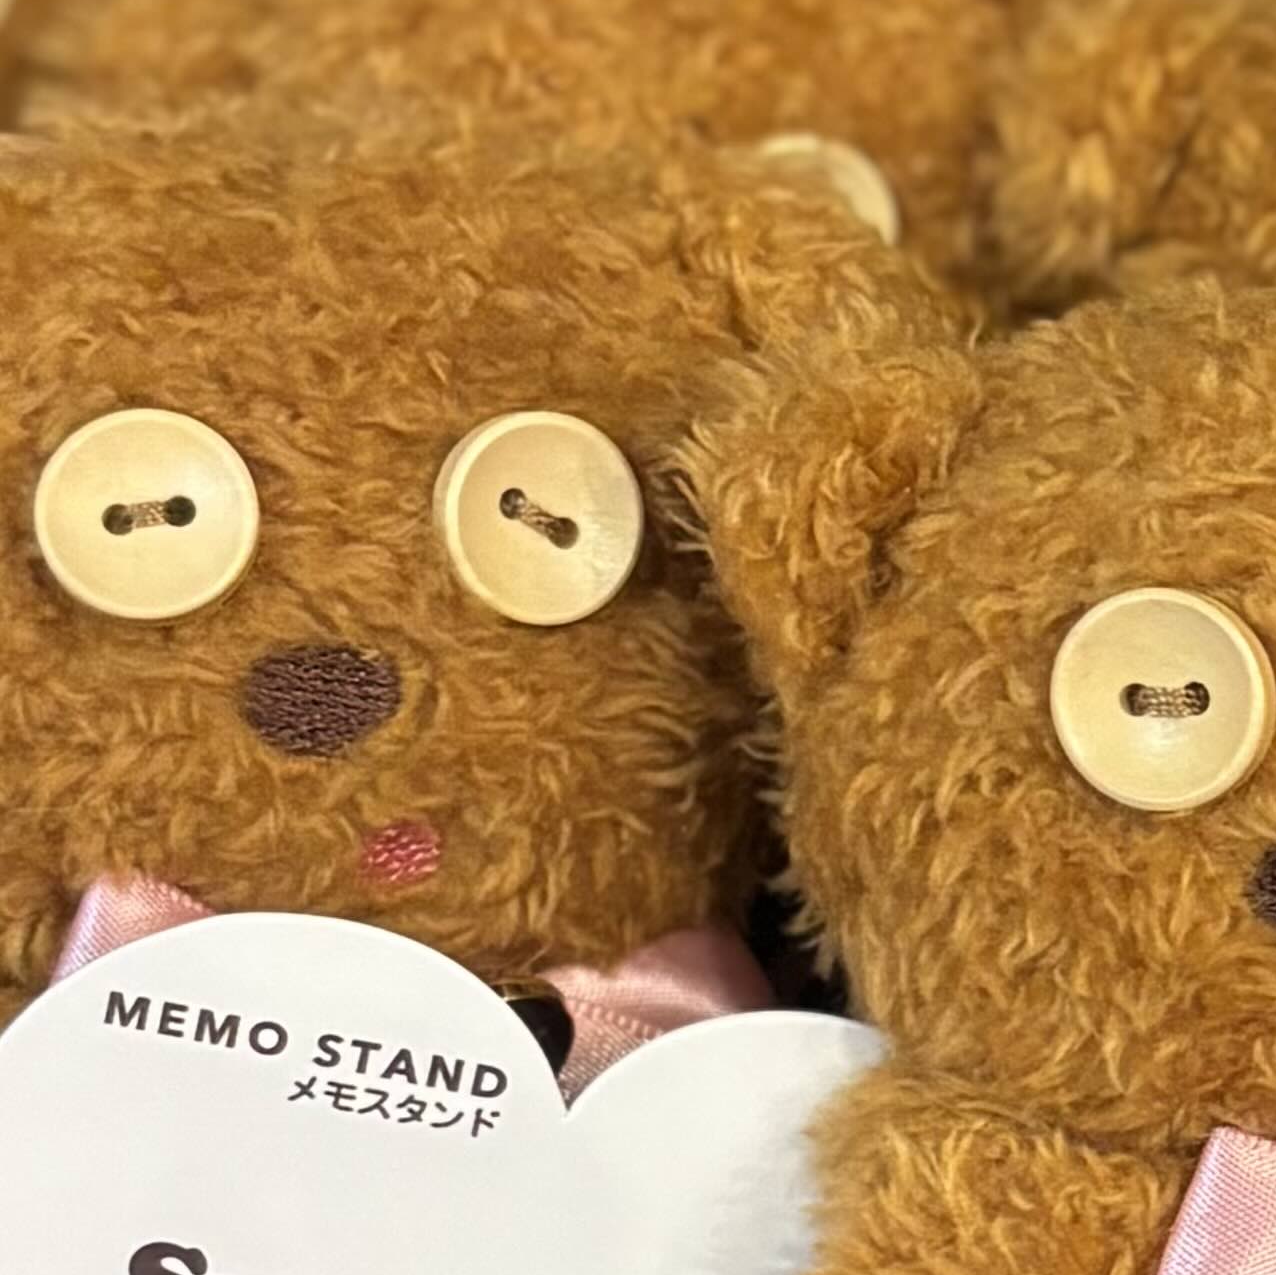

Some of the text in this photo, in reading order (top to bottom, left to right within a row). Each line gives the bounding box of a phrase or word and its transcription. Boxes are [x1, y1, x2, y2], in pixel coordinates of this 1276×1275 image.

[104, 990, 507, 1098] MEMO STAND
[288, 1077, 501, 1137] メモスタンド
